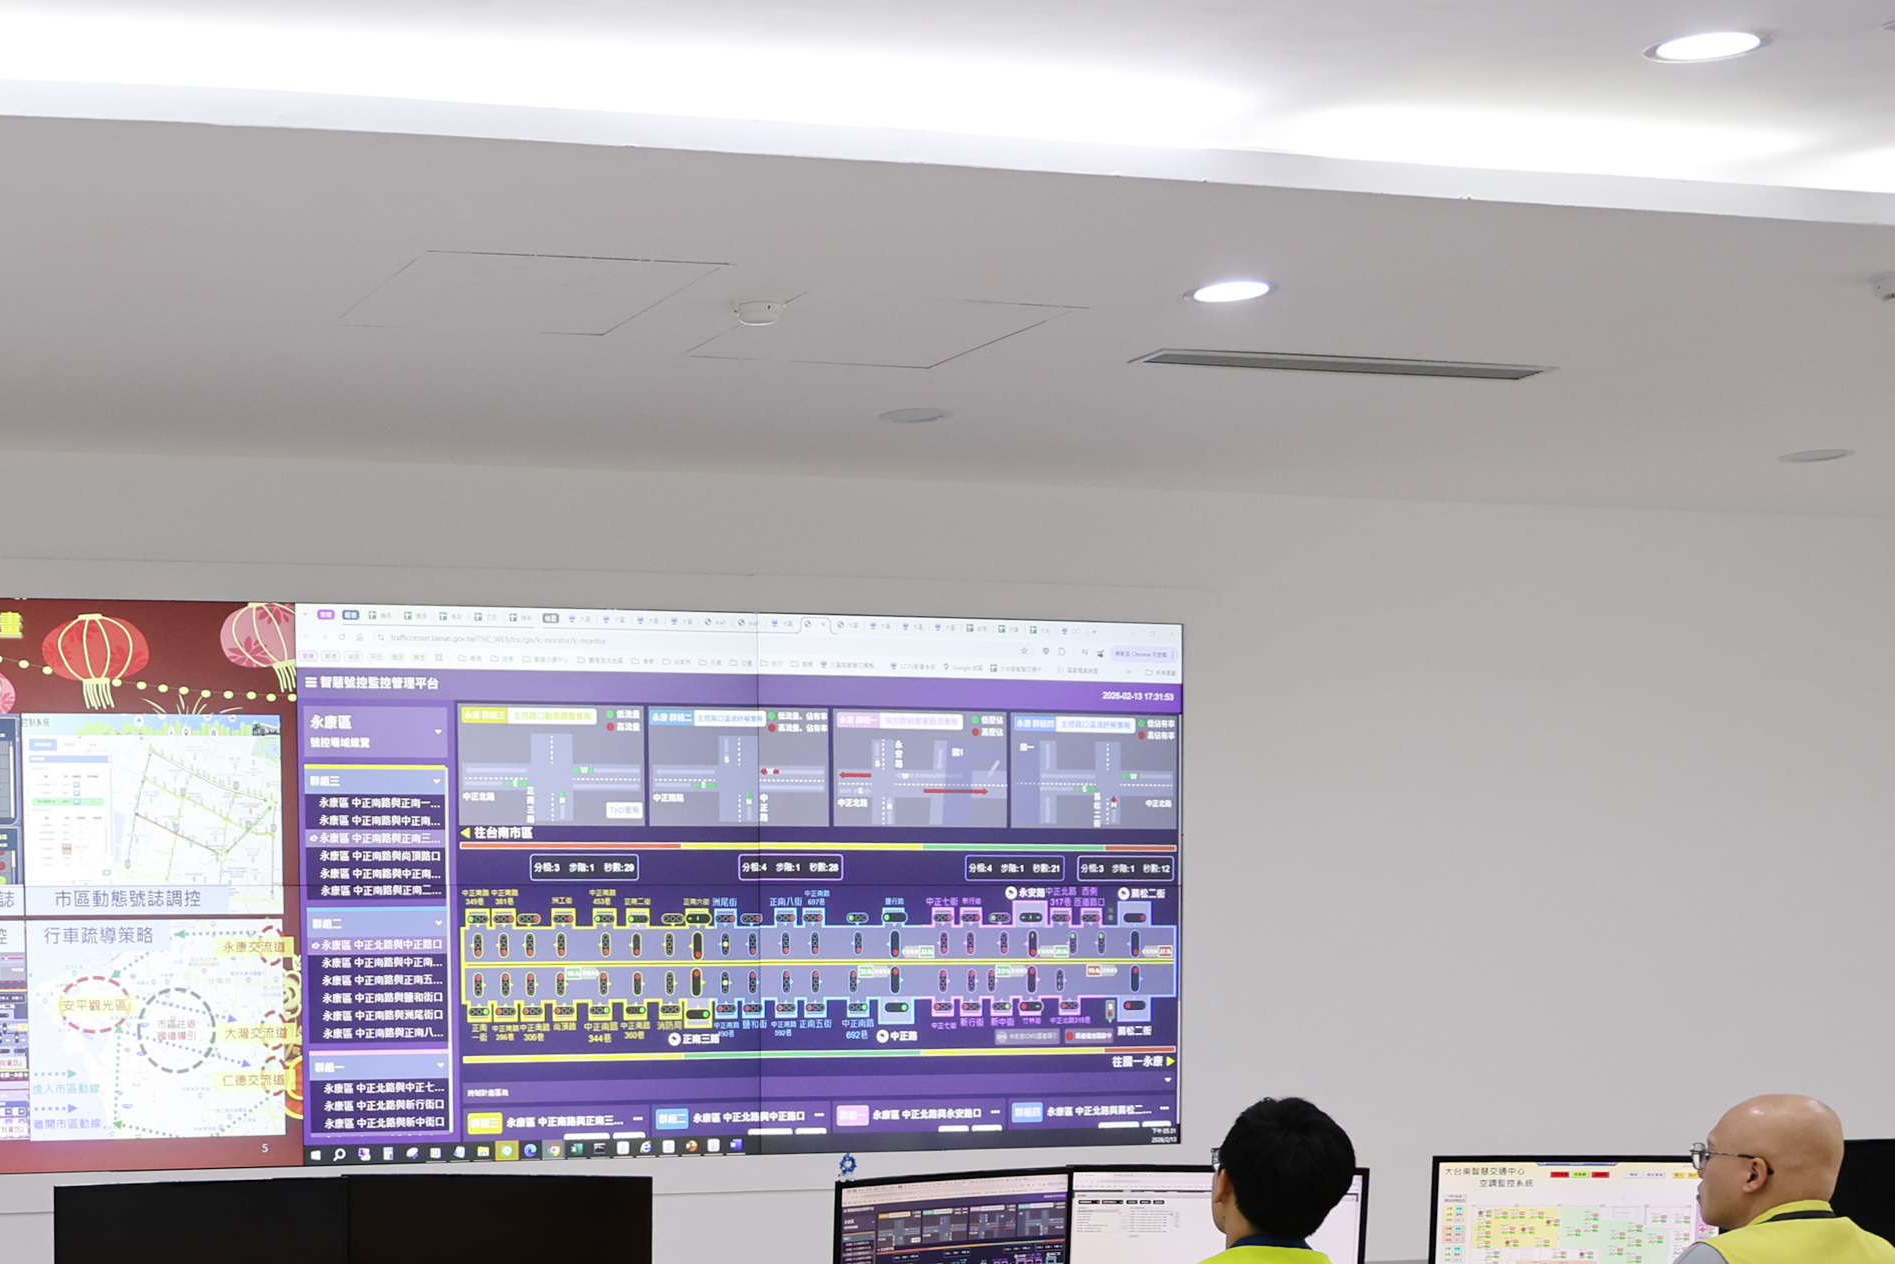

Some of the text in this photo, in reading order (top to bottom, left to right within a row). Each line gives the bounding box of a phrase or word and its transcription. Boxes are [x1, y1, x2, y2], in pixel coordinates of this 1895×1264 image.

[320, 676, 439, 690] 智慧號控監控管理平台
[1103, 691, 1174, 701] 2026-02-13 17:31:53
[310, 715, 352, 730] 永康區
[310, 776, 340, 786] 群組三
[319, 797, 349, 808] 永康區
[319, 815, 349, 826] 永康區
[320, 833, 349, 844] 永康區
[474, 827, 533, 839] 往台南市區
[320, 851, 350, 861] 永康區
[320, 868, 350, 879] 永康區
[320, 885, 351, 896] 永康區
[1019, 888, 1046, 898] 永安路
[55, 889, 201, 908] 市區動態號誌調控
[312, 918, 342, 929] 群組二
[44, 927, 153, 944] 行車疏導策略
[223, 941, 285, 953] 永康交流道
[321, 940, 442, 950] 永康區 中正北路與中正路口
[322, 958, 351, 968] 永康區
[322, 975, 352, 986] 永康區
[322, 993, 352, 1004] 永康區
[63, 999, 127, 1012] 安平觀光區
[322, 1011, 352, 1021] 永康區
[157, 1020, 196, 1029] 市區往返
[225, 1027, 286, 1039] 大灣交流道
[323, 1028, 353, 1039] 永康區
[891, 1031, 918, 1041] 中正路
[682, 1034, 720, 1045] 正南三路
[1112, 1056, 1163, 1067] 往國一永康
[315, 1062, 345, 1073] 群組一
[223, 1074, 285, 1087] 仁德交流道
[33, 1084, 100, 1095] 進入市區動線
[324, 1083, 353, 1094] 永康區
[324, 1100, 444, 1112] 永康區 中正北路與新行街口
[693, 1112, 721, 1124] 永康區
[723, 1110, 805, 1123] 中正北路與中正路口
[873, 1109, 900, 1121] 永康區
[902, 1108, 981, 1120] 中正北路與永安路口
[34, 1118, 100, 1130] 離開市區動線
[325, 1117, 445, 1129] 永康區 中正北路與新中街口
[507, 1116, 535, 1128] 永康區
[261, 1143, 269, 1152] 5
[1444, 1167, 1525, 1176] 大台南智慧交通中心
[1479, 1179, 1534, 1188] 空調監控系統
